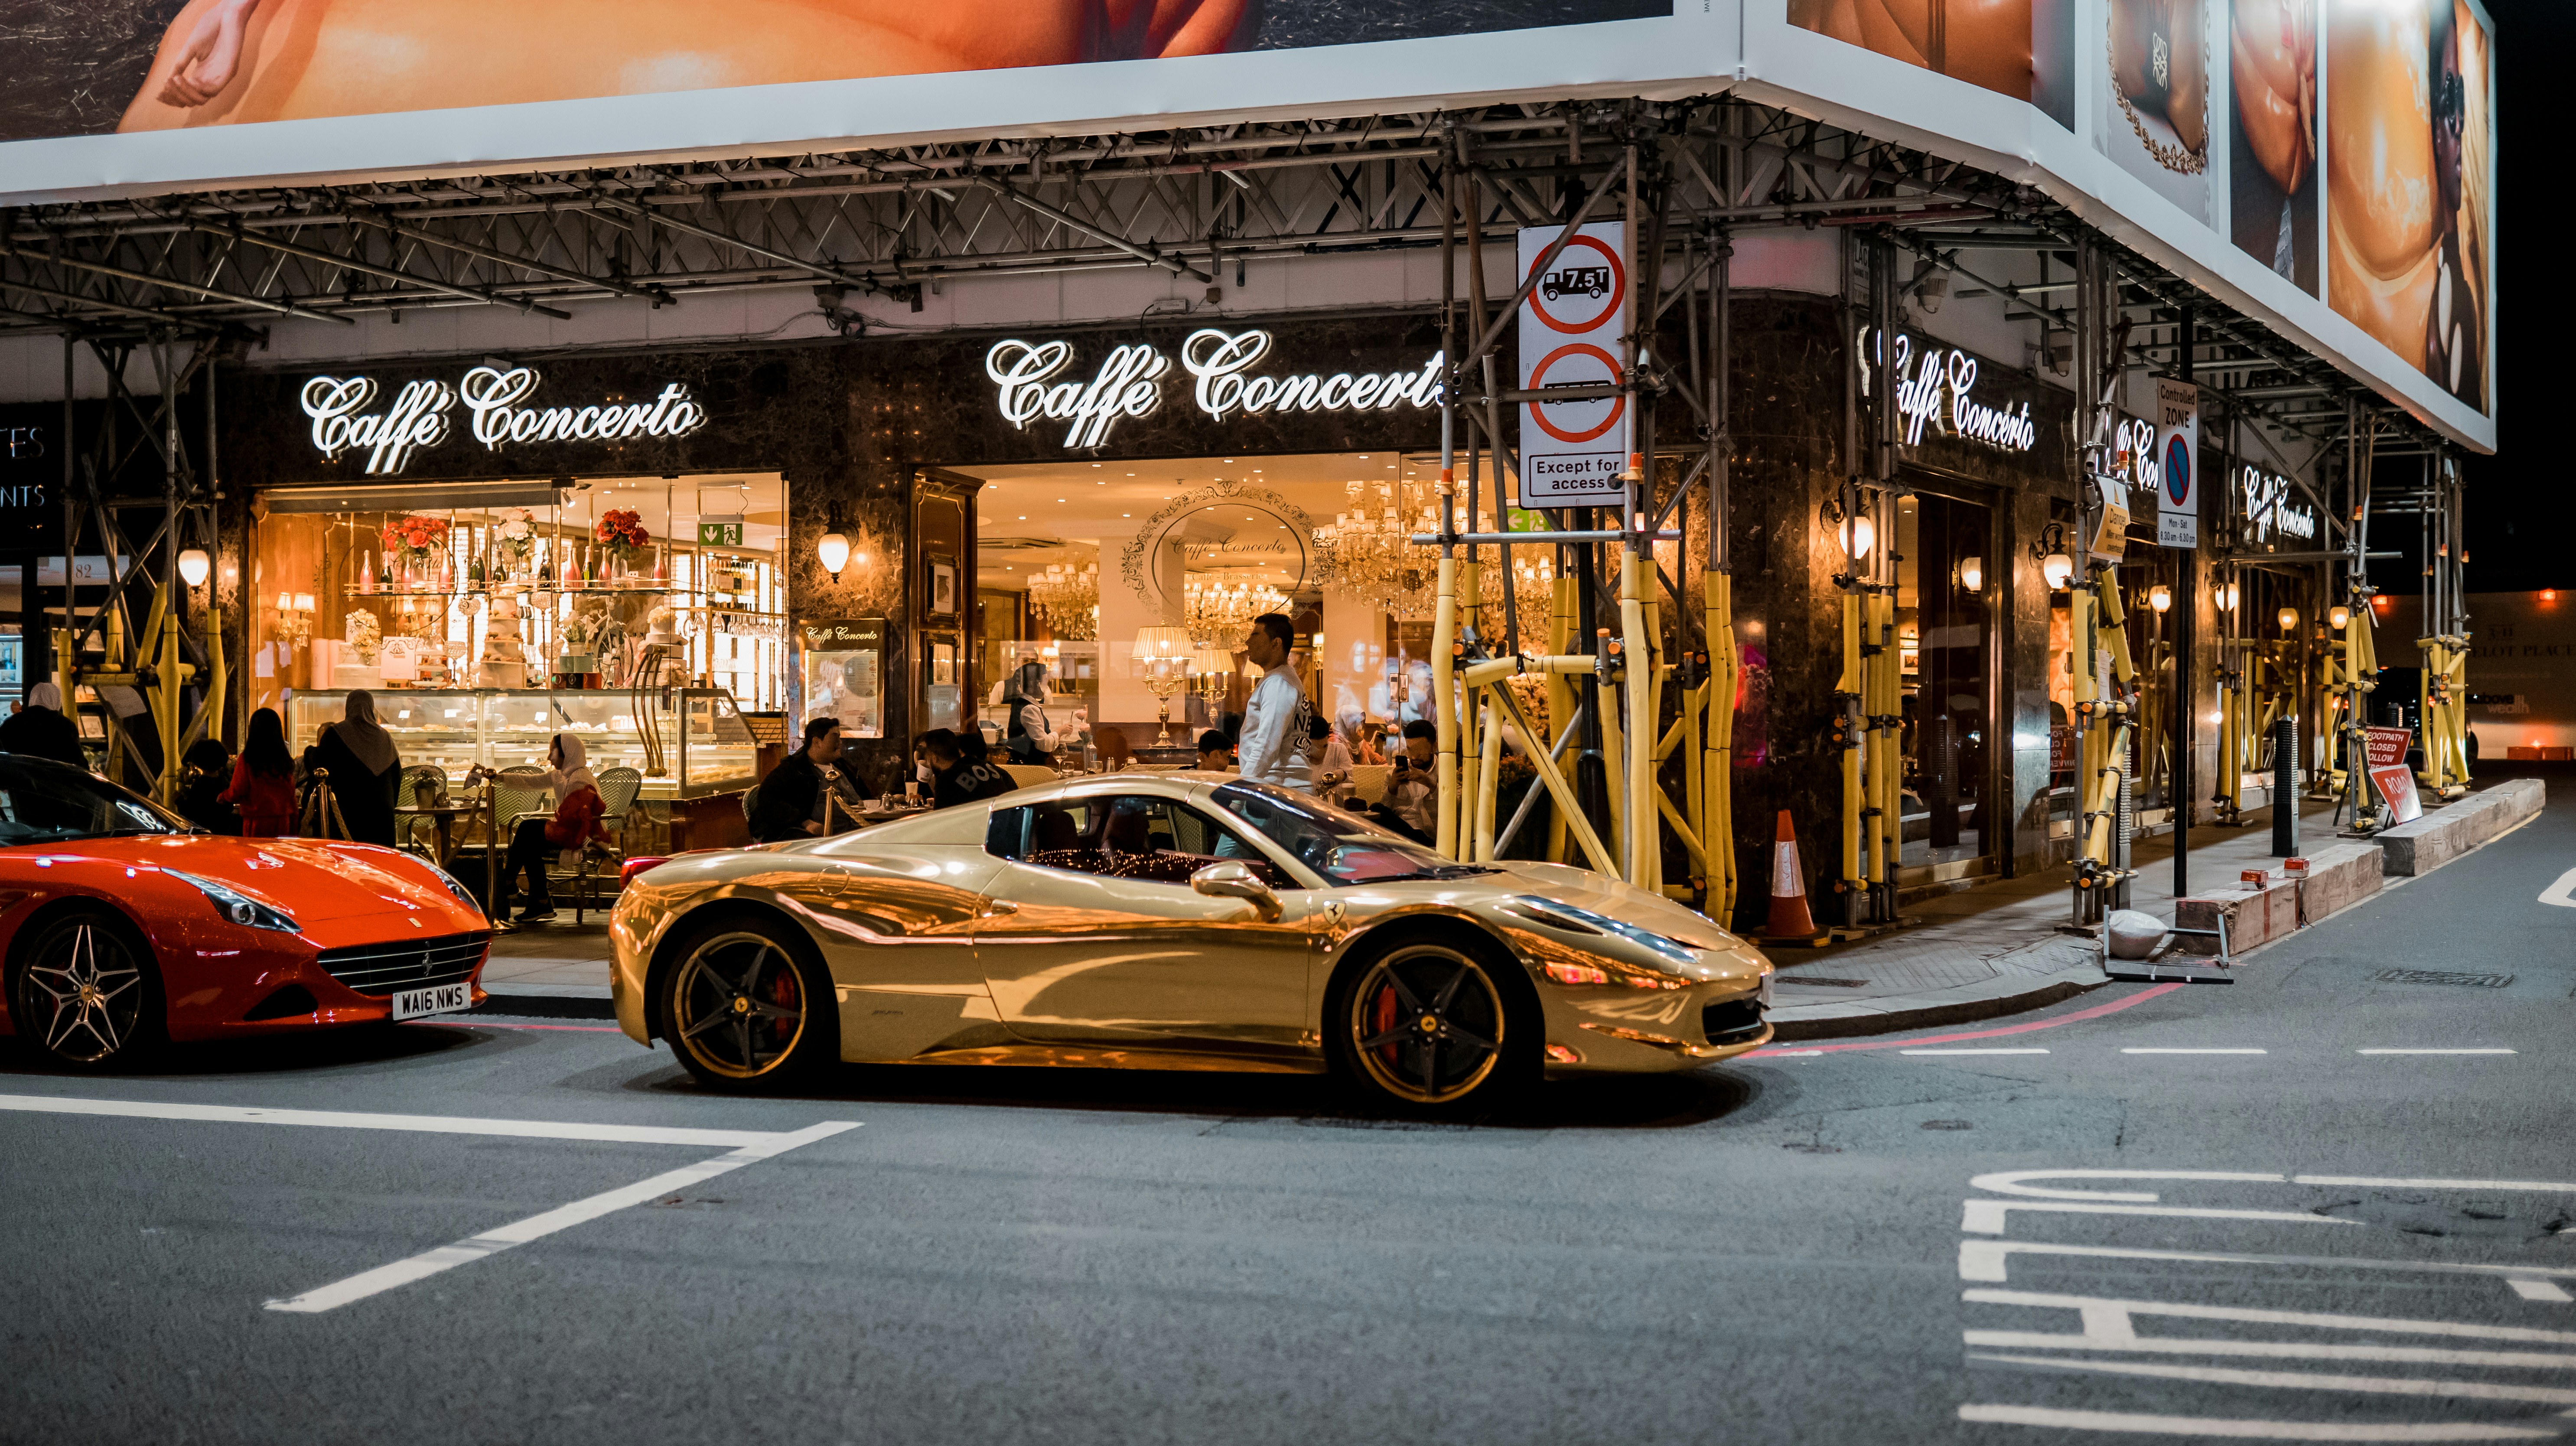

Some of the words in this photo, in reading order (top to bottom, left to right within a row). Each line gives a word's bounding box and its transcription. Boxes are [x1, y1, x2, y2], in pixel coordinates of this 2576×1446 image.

[1566, 269, 1607, 288] 7.5T
[986, 339, 1169, 448] Caffé
[1182, 329, 1443, 423] Concert
[2160, 384, 2195, 405] Controlled
[1949, 349, 2035, 451] Concerto
[301, 376, 450, 474] Caffé
[461, 367, 698, 451] Concerto
[2166, 407, 2190, 429] ZONE
[0, 426, 44, 459] ES
[1537, 459, 1591, 475] Except
[1597, 459, 1619, 472] for
[1552, 479, 1605, 490] access
[2169, 518, 2178, 528] Mon
[1218, 534, 1285, 553] Concerto
[75, 564, 91, 578] 82
[1223, 571, 1263, 580] Brasserie
[835, 626, 877, 640] Concerto
[2368, 732, 2404, 742] FOOTPATH
[2368, 743, 2397, 752] CLOSED
[2368, 753, 2394, 762] OLLOW
[402, 991, 433, 1014] WA16
[436, 987, 463, 1009] NWS
